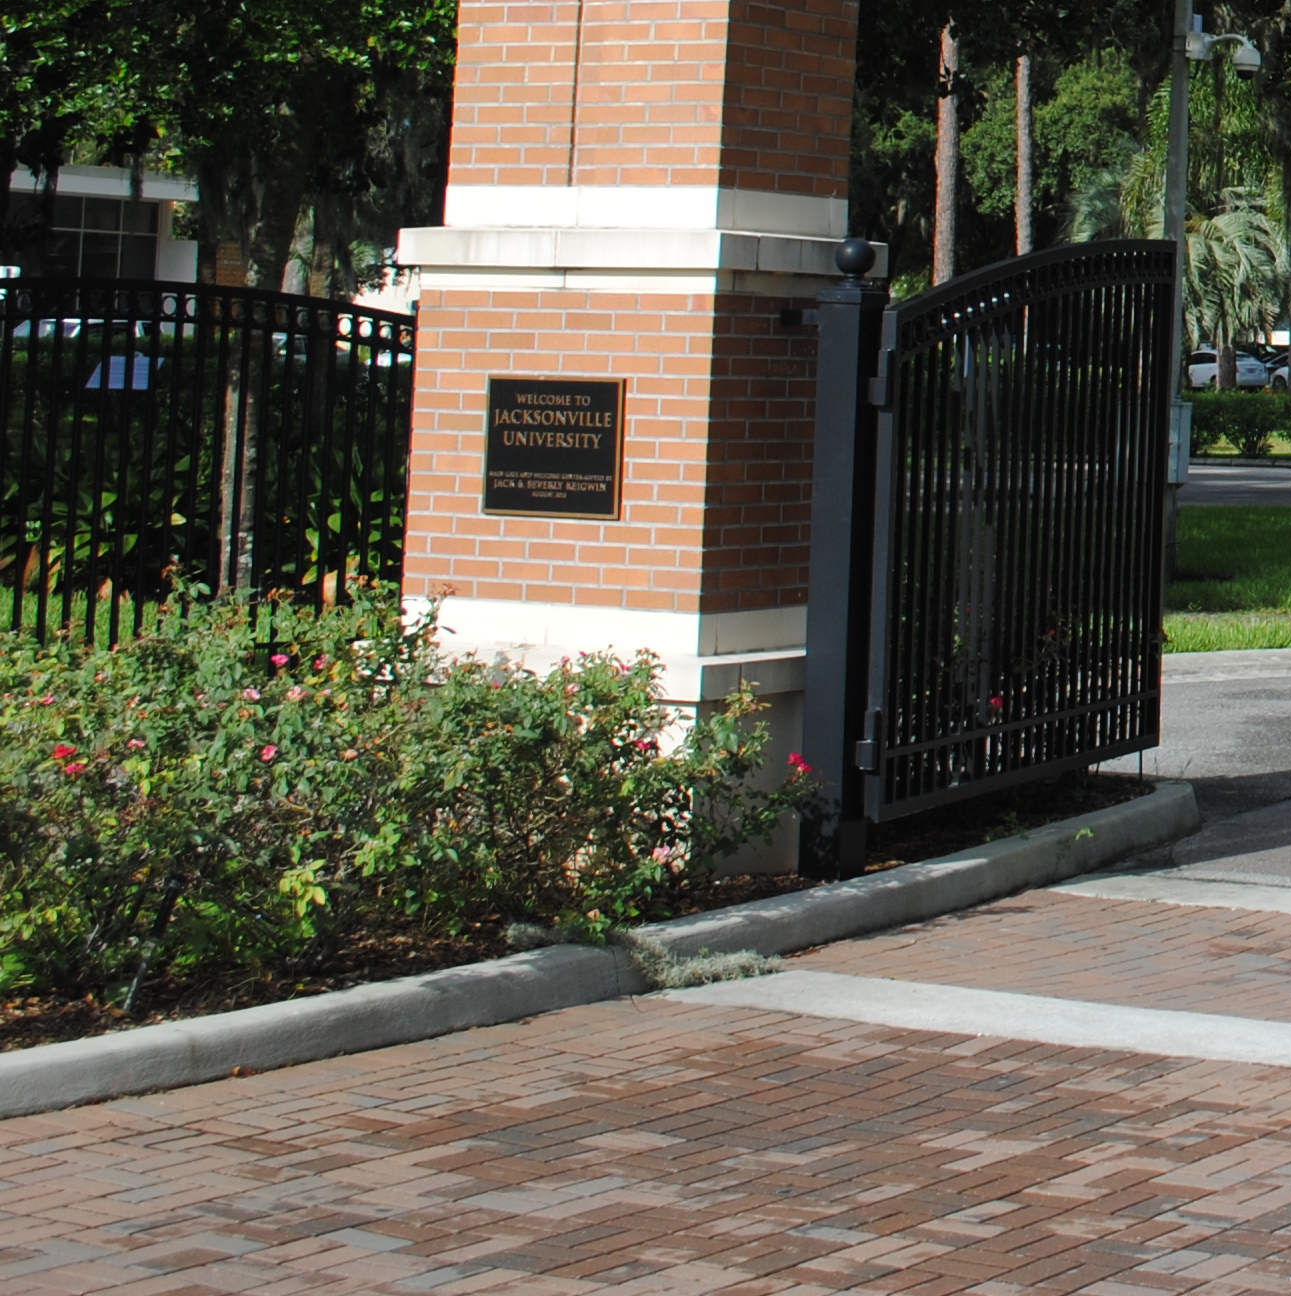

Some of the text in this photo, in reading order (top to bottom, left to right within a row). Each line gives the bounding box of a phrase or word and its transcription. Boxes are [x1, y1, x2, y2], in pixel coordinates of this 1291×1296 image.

[517, 394, 591, 406] WELCOME TO
[494, 409, 612, 427] JACKSONVILLE
[503, 431, 602, 449] UNIVERSITY
[494, 478, 515, 489] JACK
[517, 480, 525, 488] &
[527, 480, 563, 490] BEVERLY
